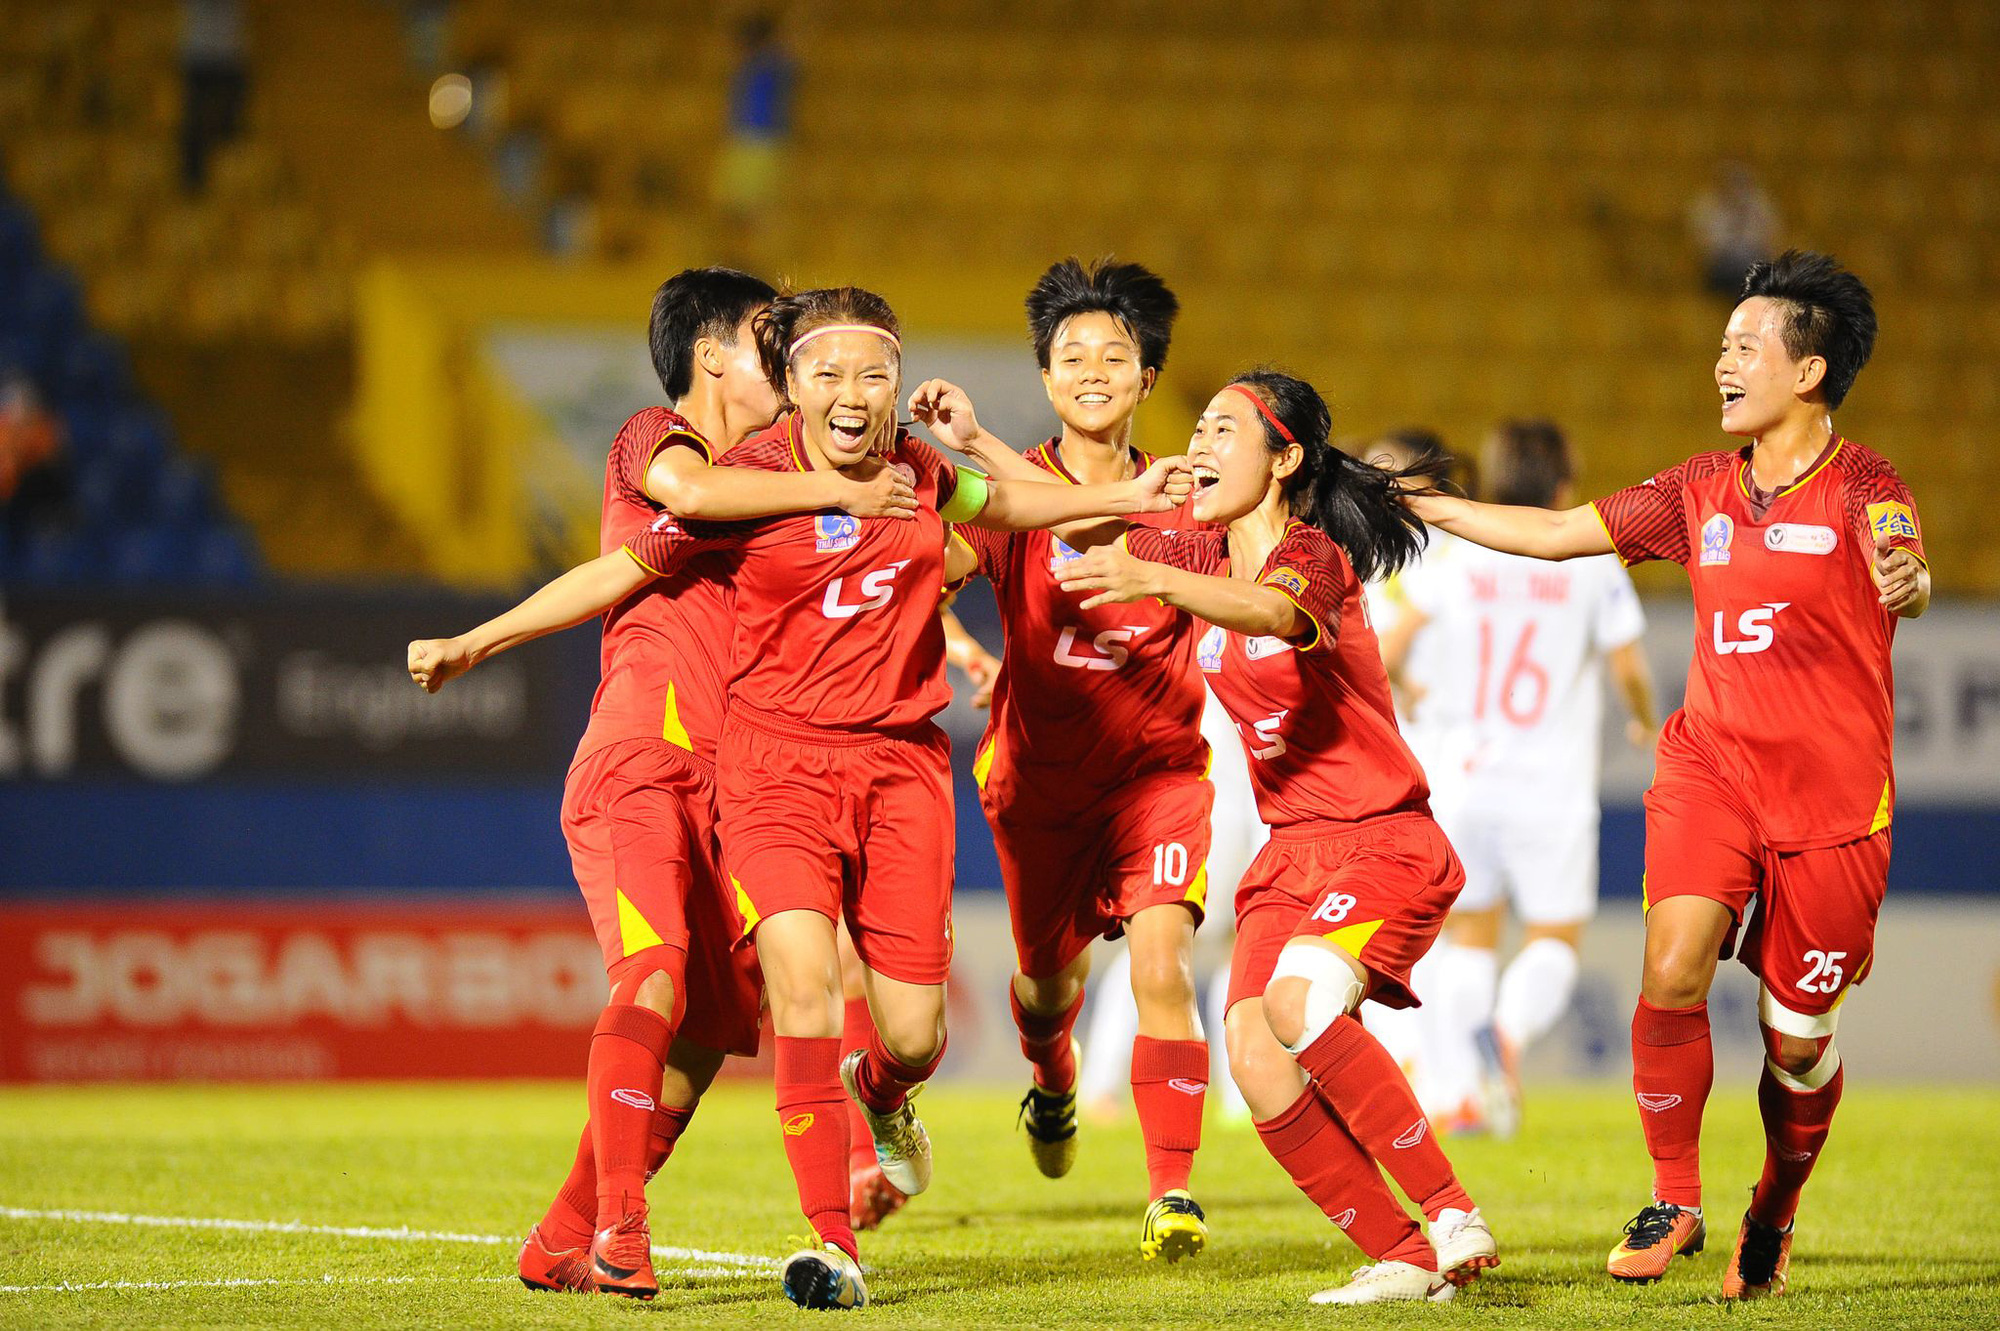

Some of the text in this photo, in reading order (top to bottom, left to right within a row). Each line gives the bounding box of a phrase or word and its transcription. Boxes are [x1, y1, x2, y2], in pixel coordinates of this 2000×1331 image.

[822, 567, 896, 618] LS
[1053, 625, 1131, 671] LS
[1714, 607, 1773, 655] LS
[1474, 615, 1549, 730] 16
[1153, 842, 1187, 886] 10
[1311, 892, 1357, 923] 18
[1796, 949, 1847, 994] 25
